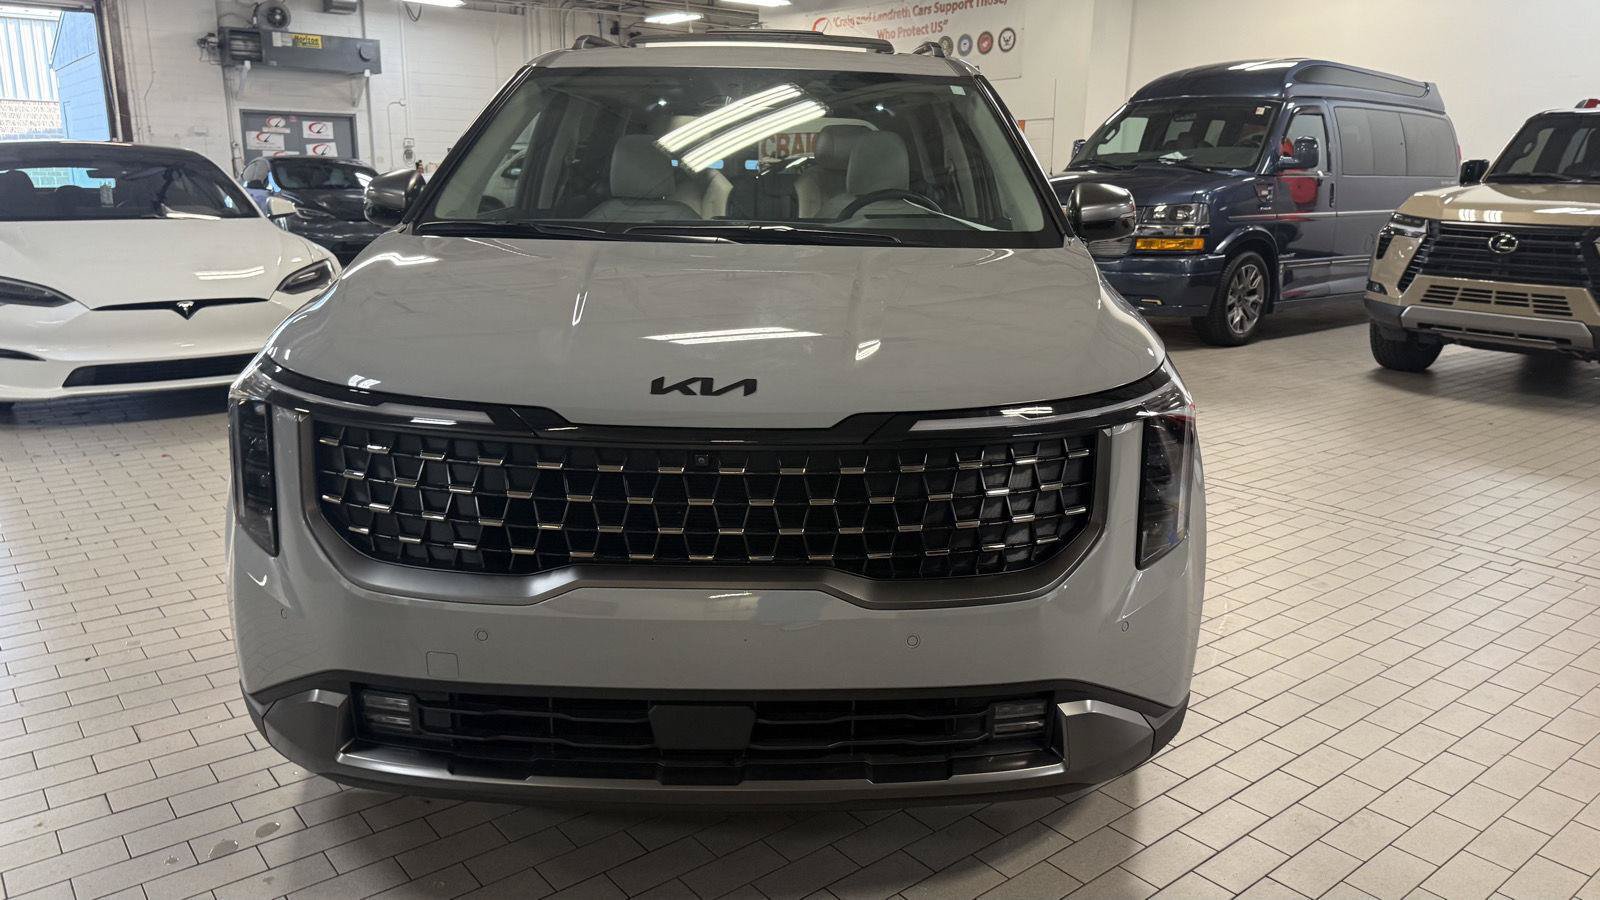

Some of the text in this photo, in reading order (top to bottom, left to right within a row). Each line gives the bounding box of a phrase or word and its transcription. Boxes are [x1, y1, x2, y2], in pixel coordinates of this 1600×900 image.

[912, 5, 932, 16] Cars
[933, 0, 973, 15] Support
[876, 28, 895, 39] Who
[897, 24, 929, 38] Protect
